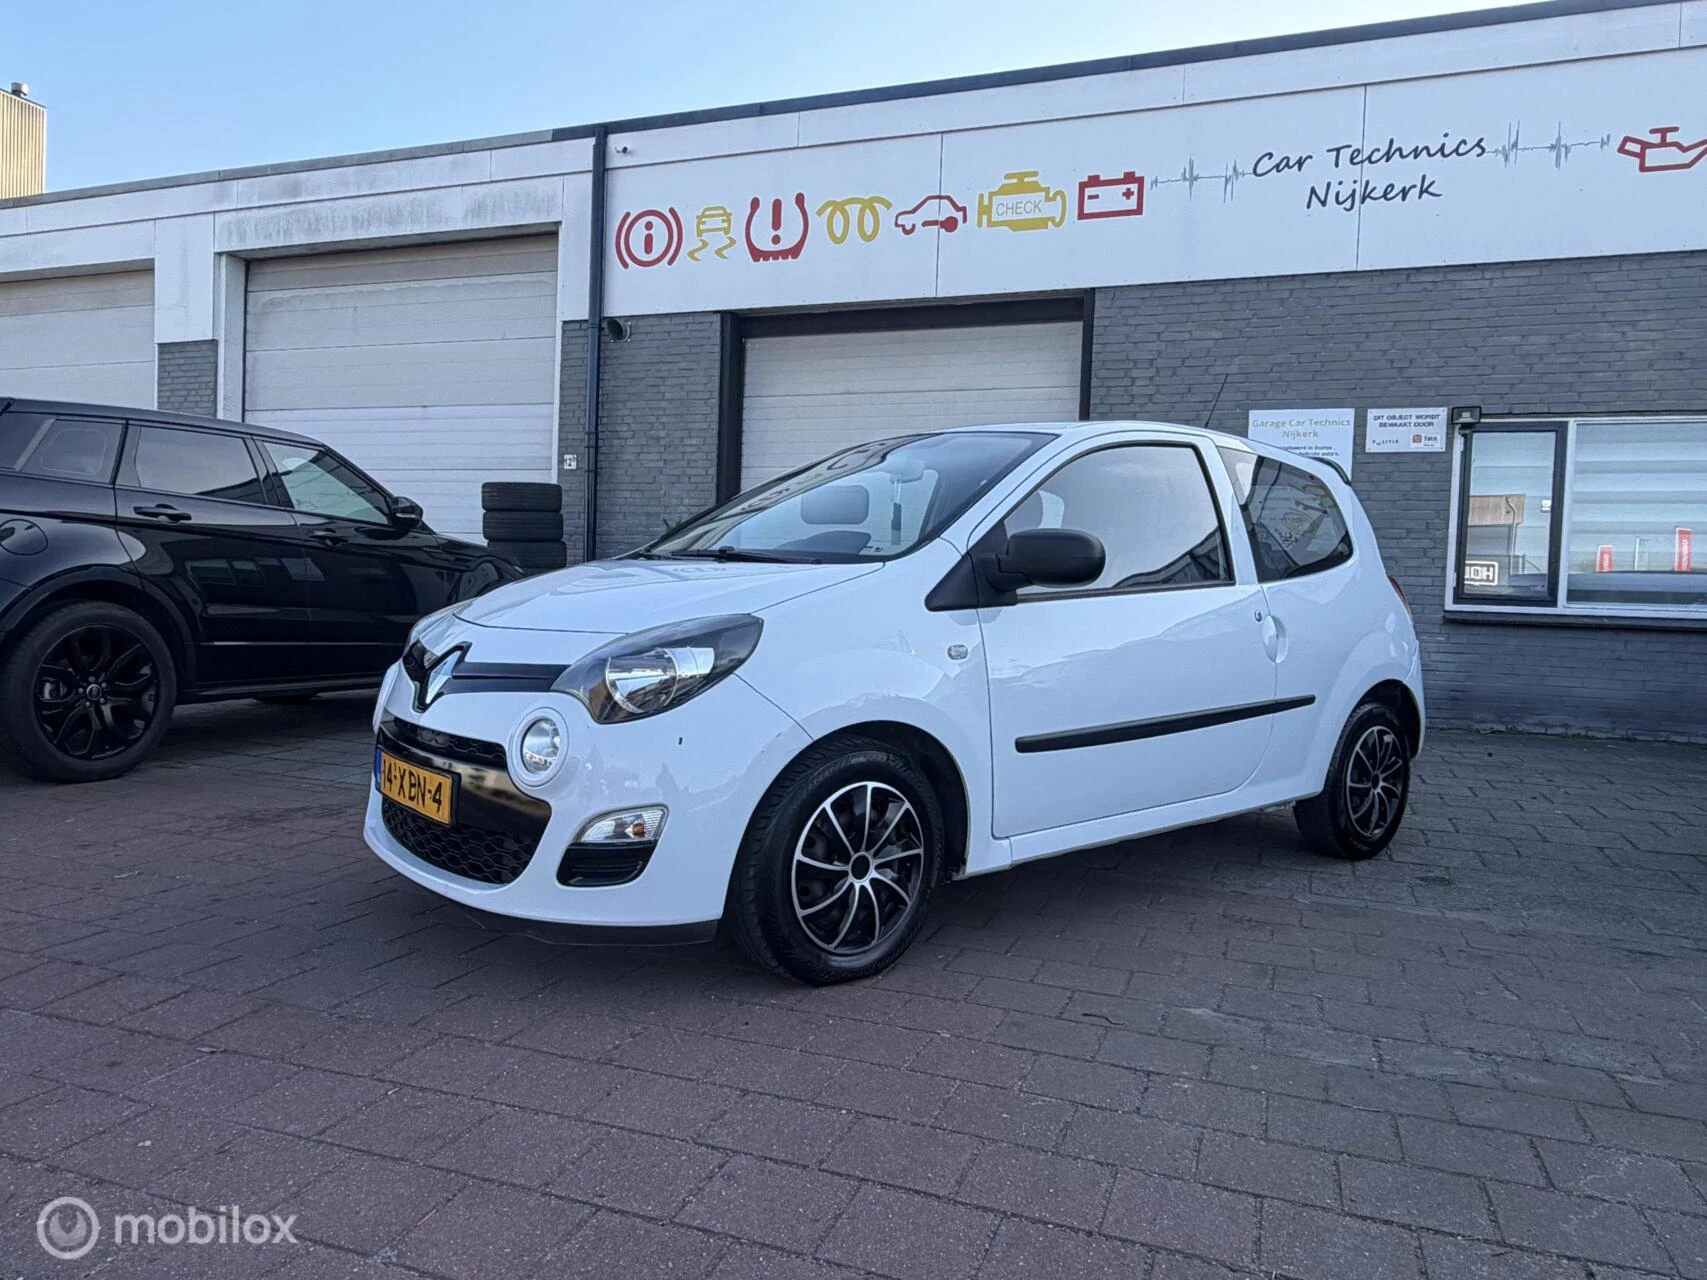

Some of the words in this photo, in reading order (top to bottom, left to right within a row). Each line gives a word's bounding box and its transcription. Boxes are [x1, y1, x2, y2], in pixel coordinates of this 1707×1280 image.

[1252, 152, 1313, 177] Car
[1326, 132, 1487, 168] Technics
[1306, 174, 1443, 212] Nijkerk
[995, 199, 1042, 217] CHECK
[1252, 419, 1286, 429] Garage
[1288, 419, 1305, 428] Car
[1307, 418, 1351, 428] Technics
[1282, 429, 1319, 440] Nijkerk
[382, 758, 443, 814] 14-XBN-4
